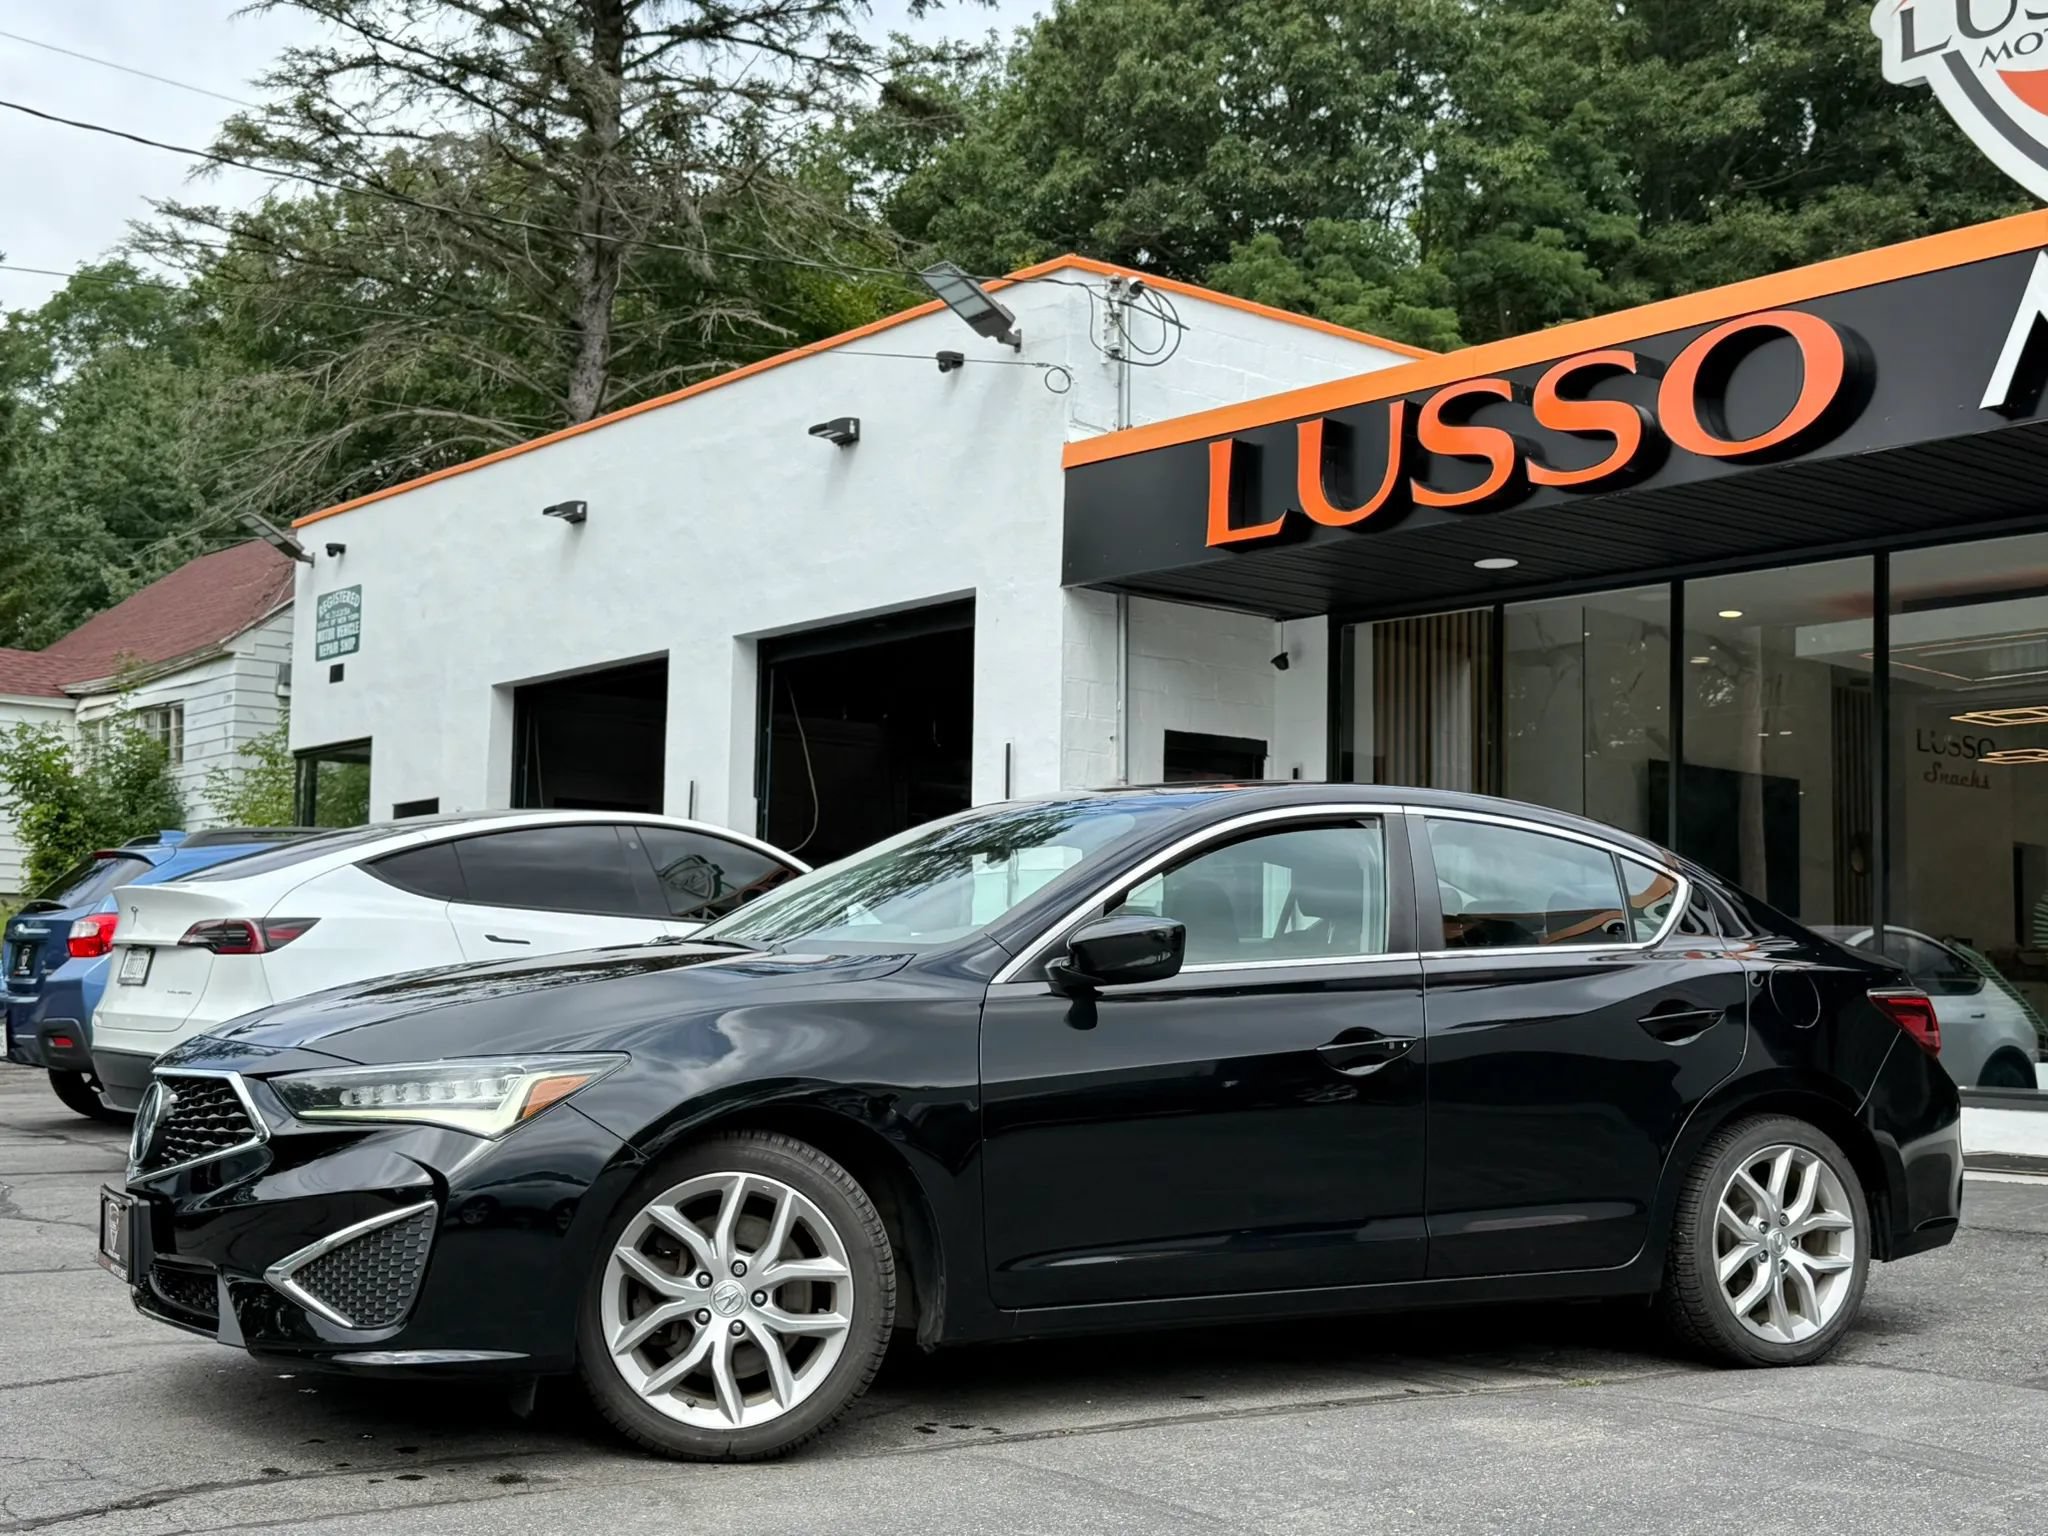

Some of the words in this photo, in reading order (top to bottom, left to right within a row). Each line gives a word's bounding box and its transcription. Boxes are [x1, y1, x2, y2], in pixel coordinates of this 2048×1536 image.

[1979, 28, 2048, 69] MO
[1204, 309, 1846, 548] LUSSO
[319, 590, 361, 618] REGISTERED
[317, 627, 336, 643] MOTOR
[336, 620, 361, 639] VEHICLE
[319, 641, 339, 657] REPAIR
[340, 636, 356, 653] SHOP
[1916, 728, 1996, 760] LUSSO
[1923, 761, 1992, 790] Snacks
